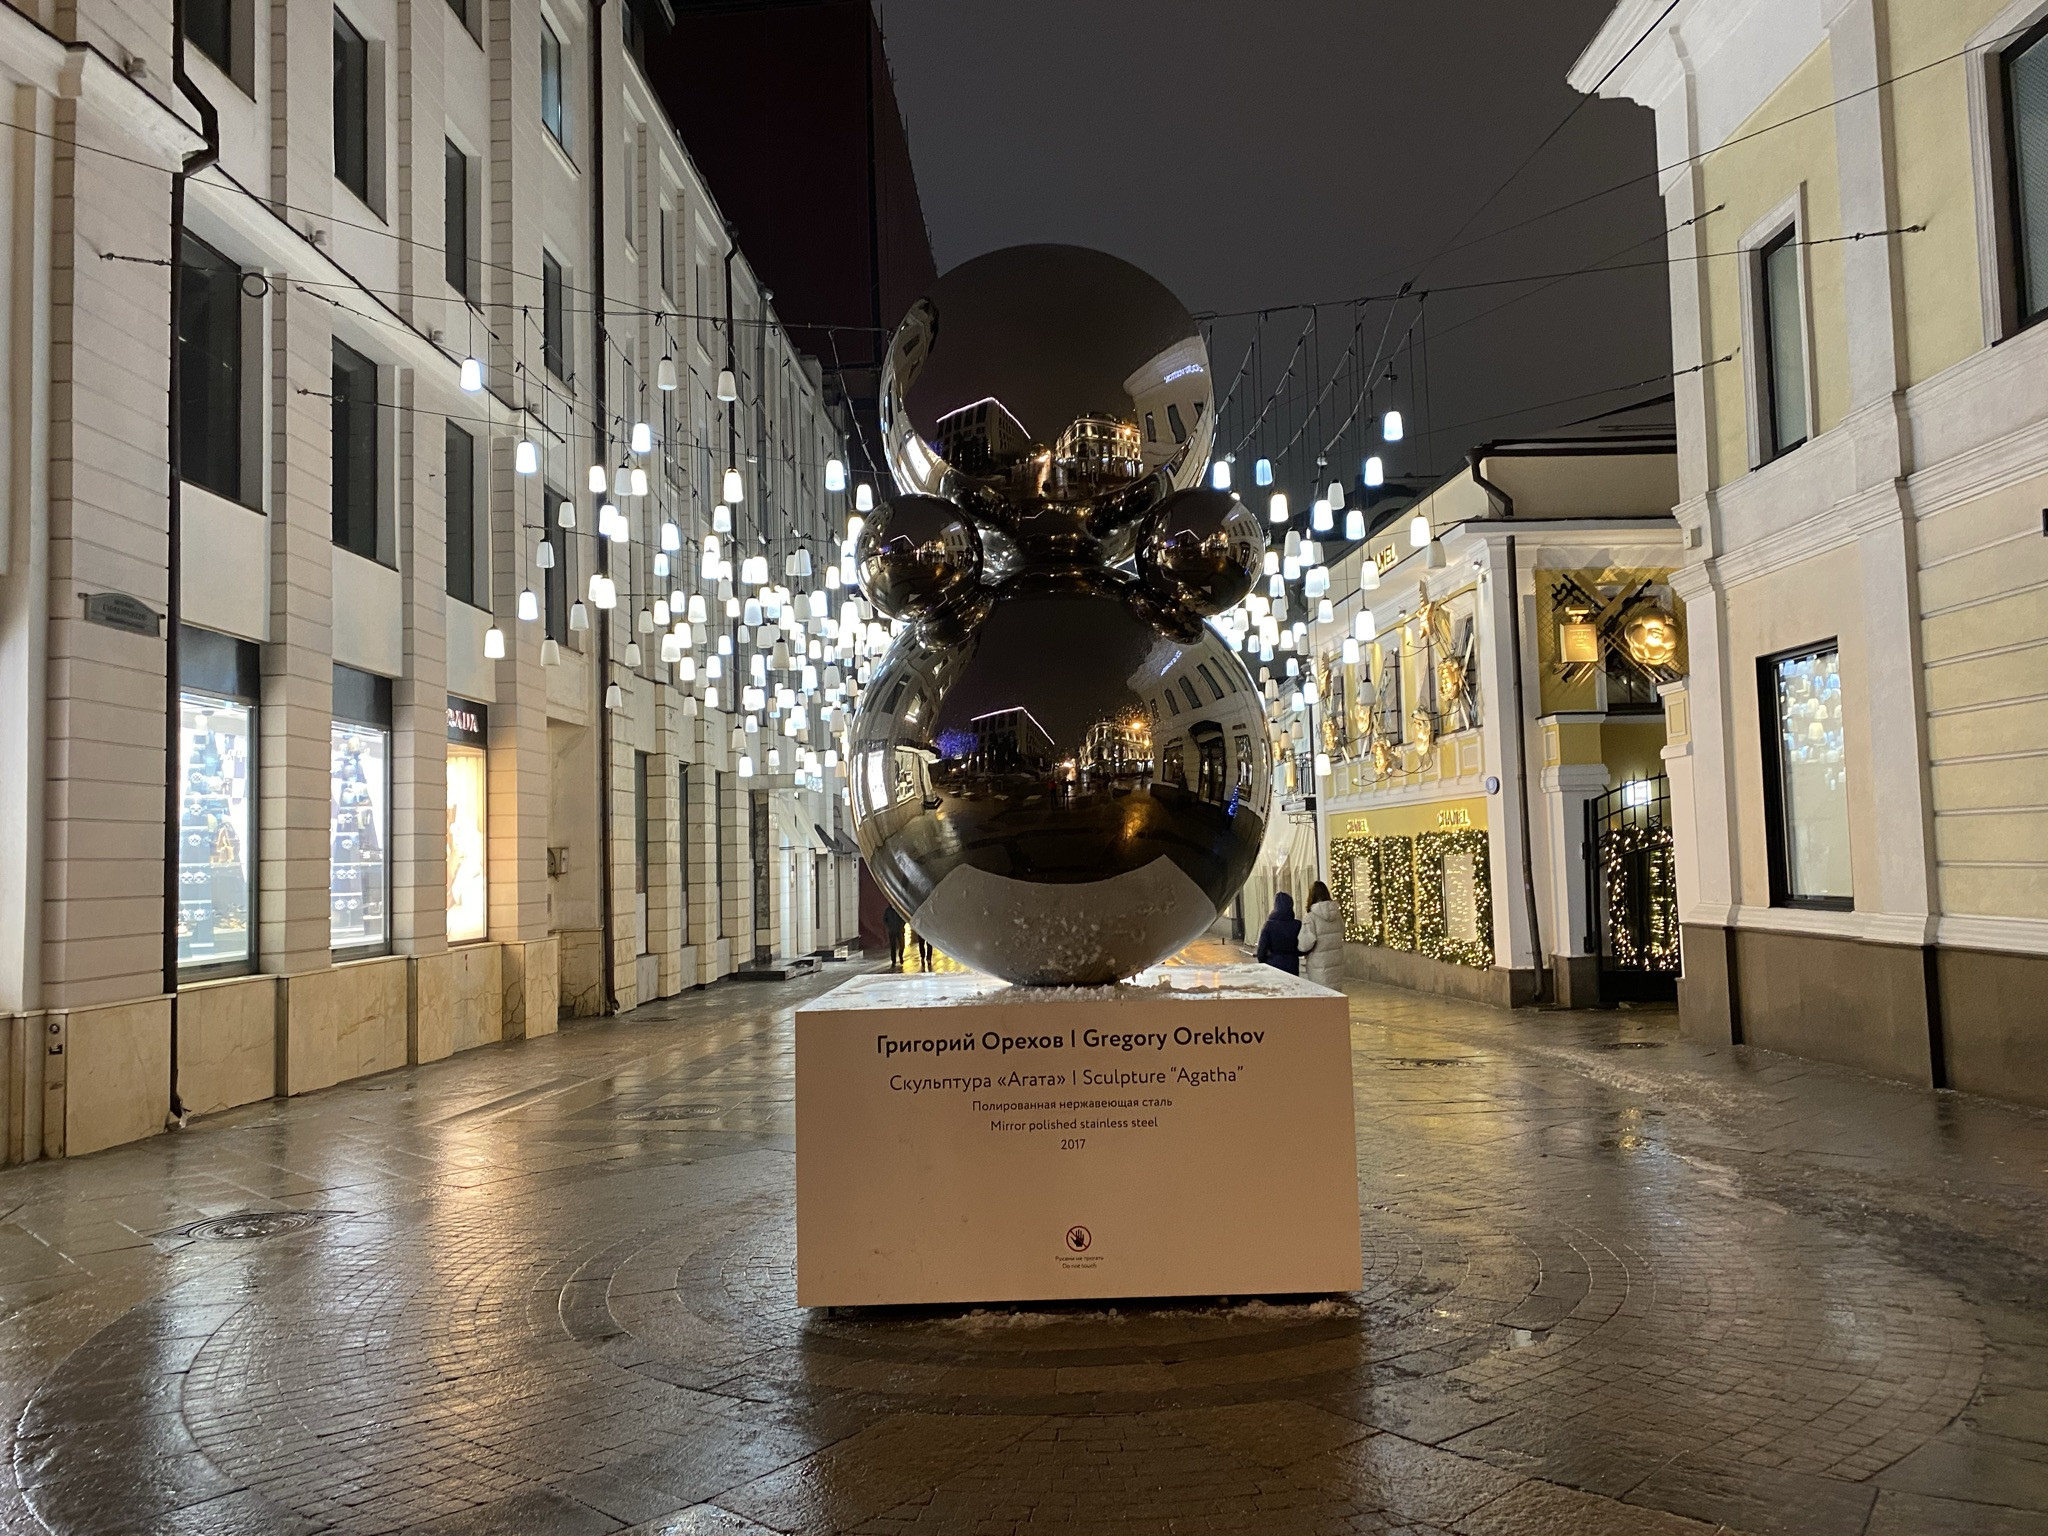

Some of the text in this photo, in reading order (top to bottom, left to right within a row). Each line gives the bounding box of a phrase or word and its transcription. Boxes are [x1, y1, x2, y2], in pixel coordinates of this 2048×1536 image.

[446, 708, 479, 733] RADA
[1437, 809, 1471, 828] CHANEL
[877, 1032, 975, 1058] Григорий
[981, 1031, 1064, 1055] Орехов
[1083, 1028, 1168, 1051] Gregory
[1173, 1026, 1265, 1045] Orekhov
[889, 1074, 992, 1094] Скульптура
[997, 1071, 1066, 1087] «Агата»
[1083, 1068, 1166, 1088] Sculpture
[972, 1099, 1173, 1113] Полированная нержавеющая сталь
[990, 1116, 1158, 1132] Mirror polished stainless steel
[1060, 1138, 1086, 1150] 2017
